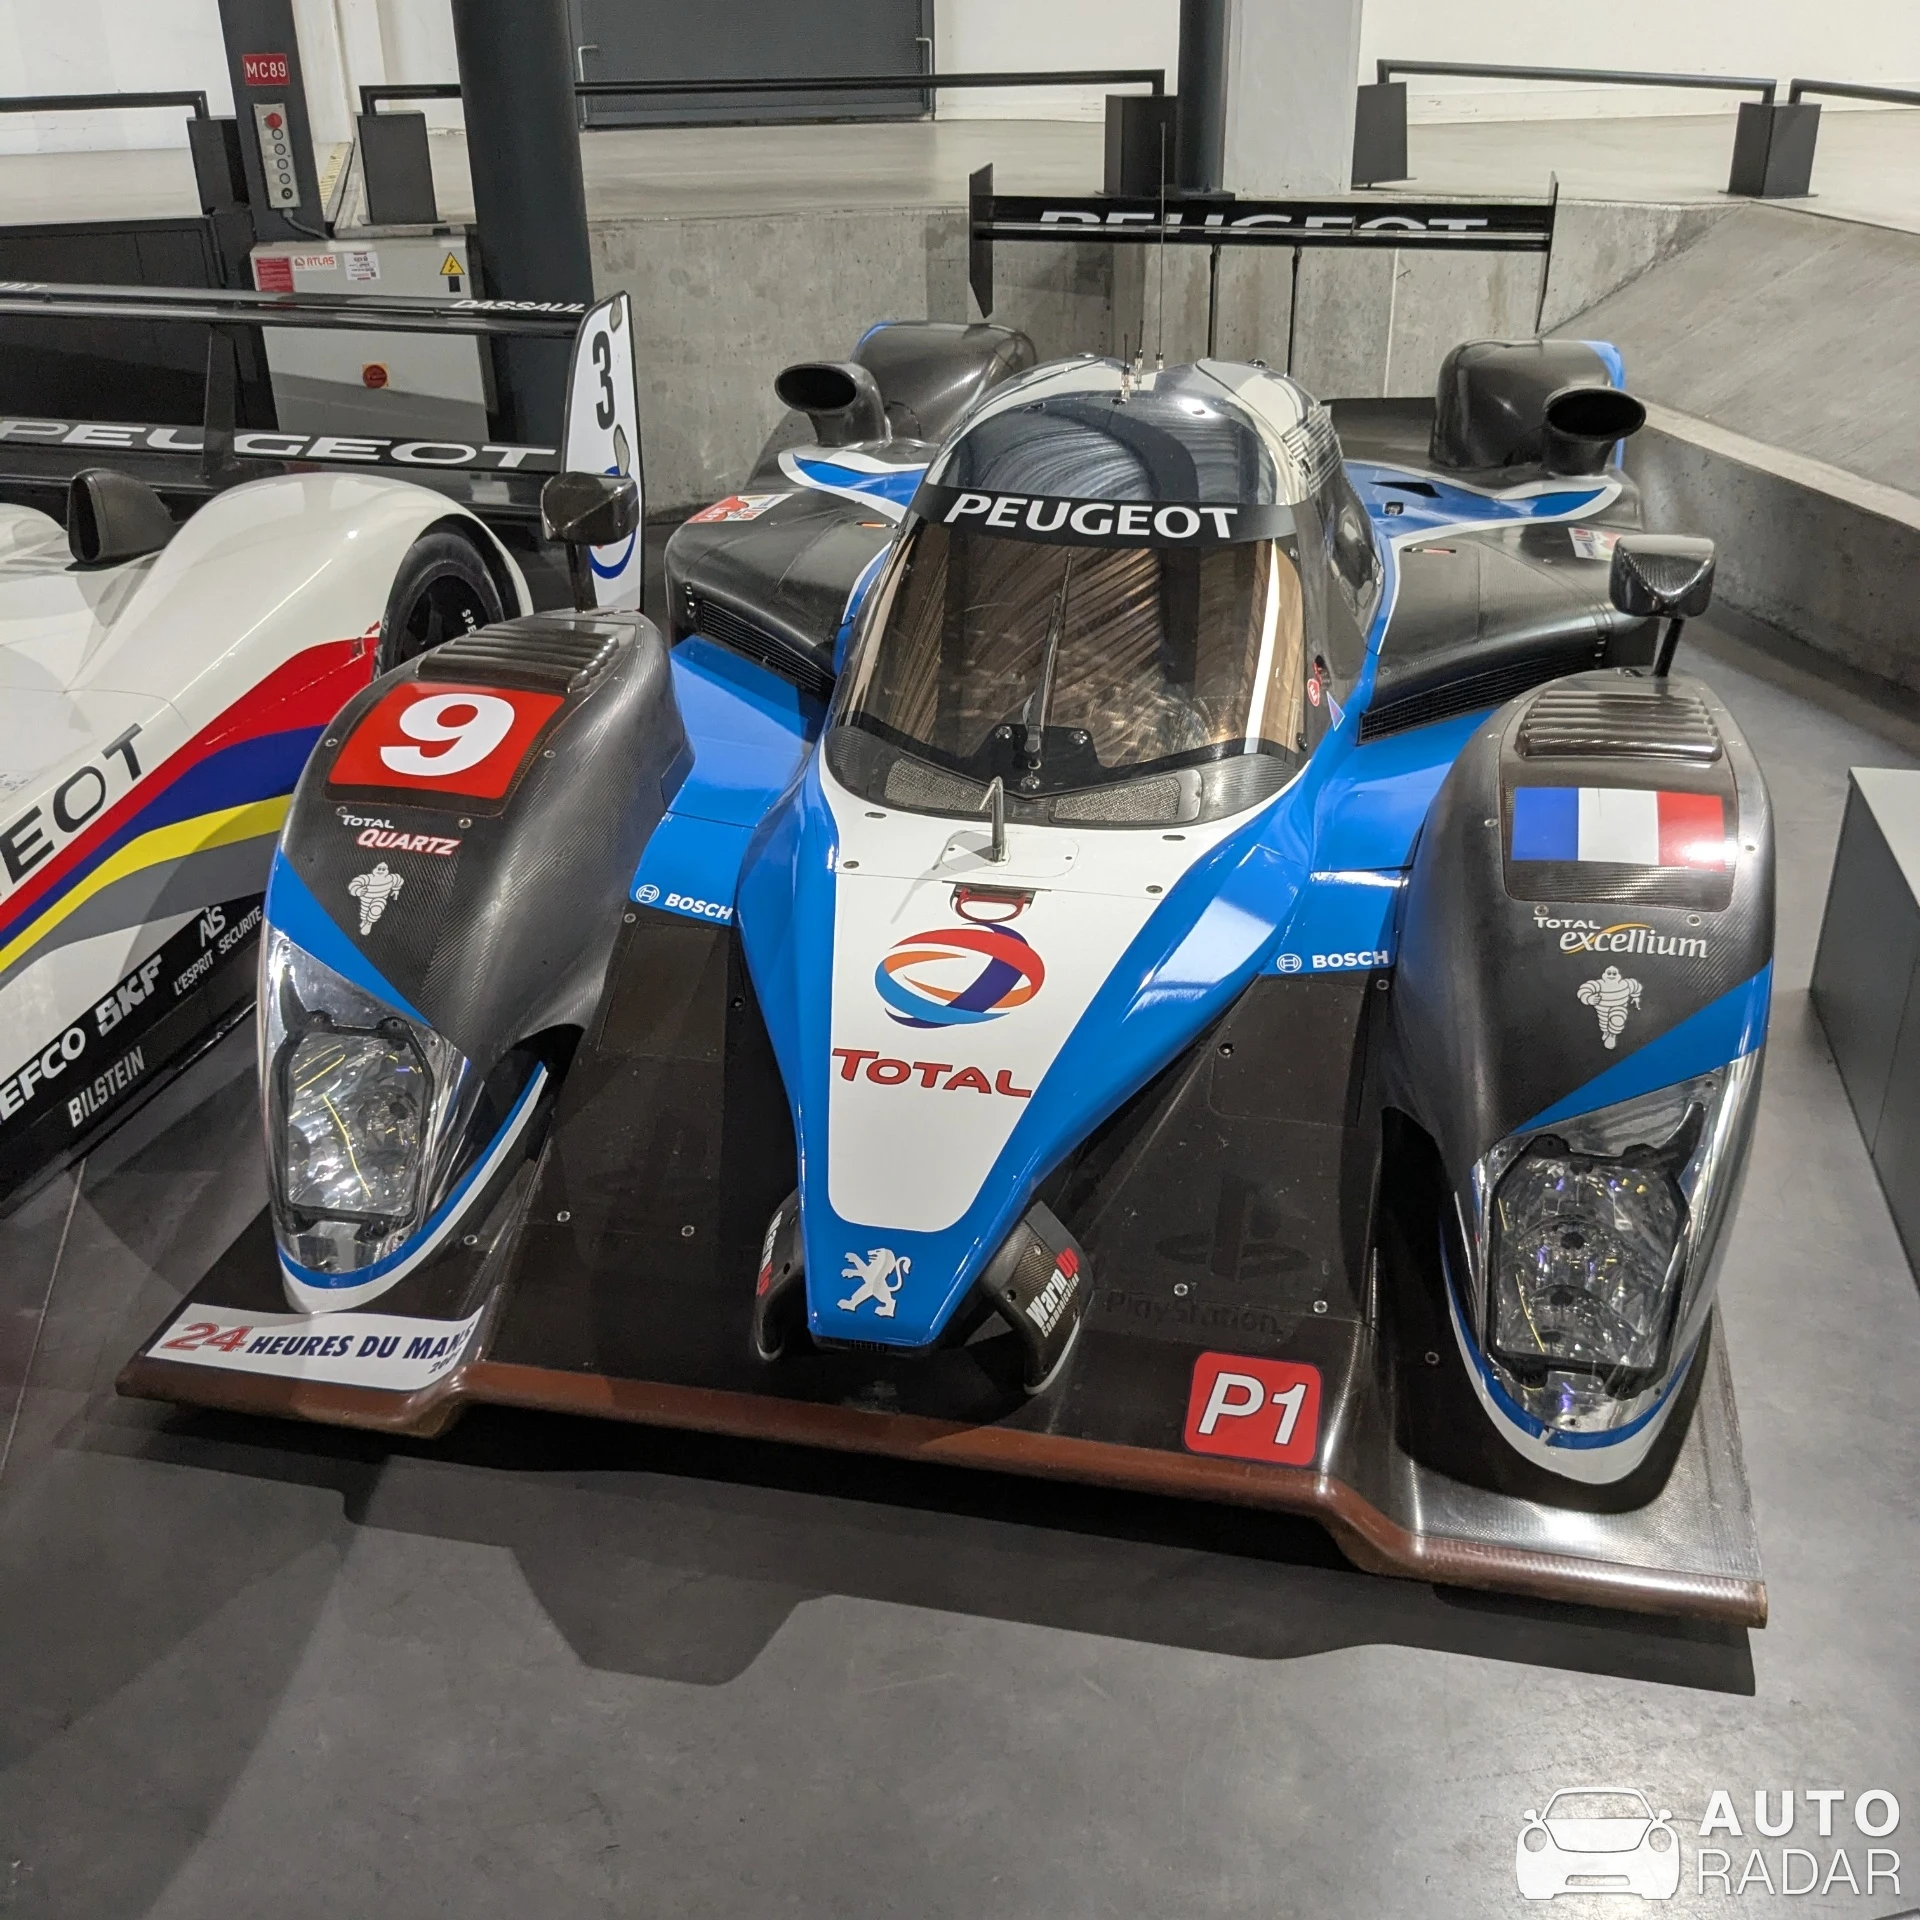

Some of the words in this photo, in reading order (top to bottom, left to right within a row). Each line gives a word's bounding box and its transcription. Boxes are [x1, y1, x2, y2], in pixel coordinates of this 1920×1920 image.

[246, 61, 287, 78] MC89
[306, 256, 335, 267] ATLAS
[592, 330, 616, 430] 3
[0, 420, 557, 468] PEUGEOT
[943, 492, 1239, 539] PEUGEOT
[380, 693, 516, 777] 9
[0, 722, 144, 885] EOT
[341, 814, 395, 830] TOTAL
[356, 828, 462, 857] QUARTZ
[664, 892, 734, 920] BOSCH
[1532, 916, 1602, 930] TOTAL
[173, 948, 214, 997] L'ESPRIT
[218, 905, 262, 955] SECURITE
[1311, 950, 1390, 969] BOSCH
[1559, 928, 1708, 959] excellium
[95, 953, 163, 1037] SKF
[0, 1026, 87, 1126] EFCO
[67, 1045, 145, 1128] BILSTEIN
[832, 1047, 1033, 1099] TOTAL
[160, 1322, 254, 1352] 24
[246, 1335, 355, 1357] HEURES
[356, 1336, 404, 1358] DU
[402, 1321, 476, 1360] MANS
[1197, 1370, 1309, 1446] P1
